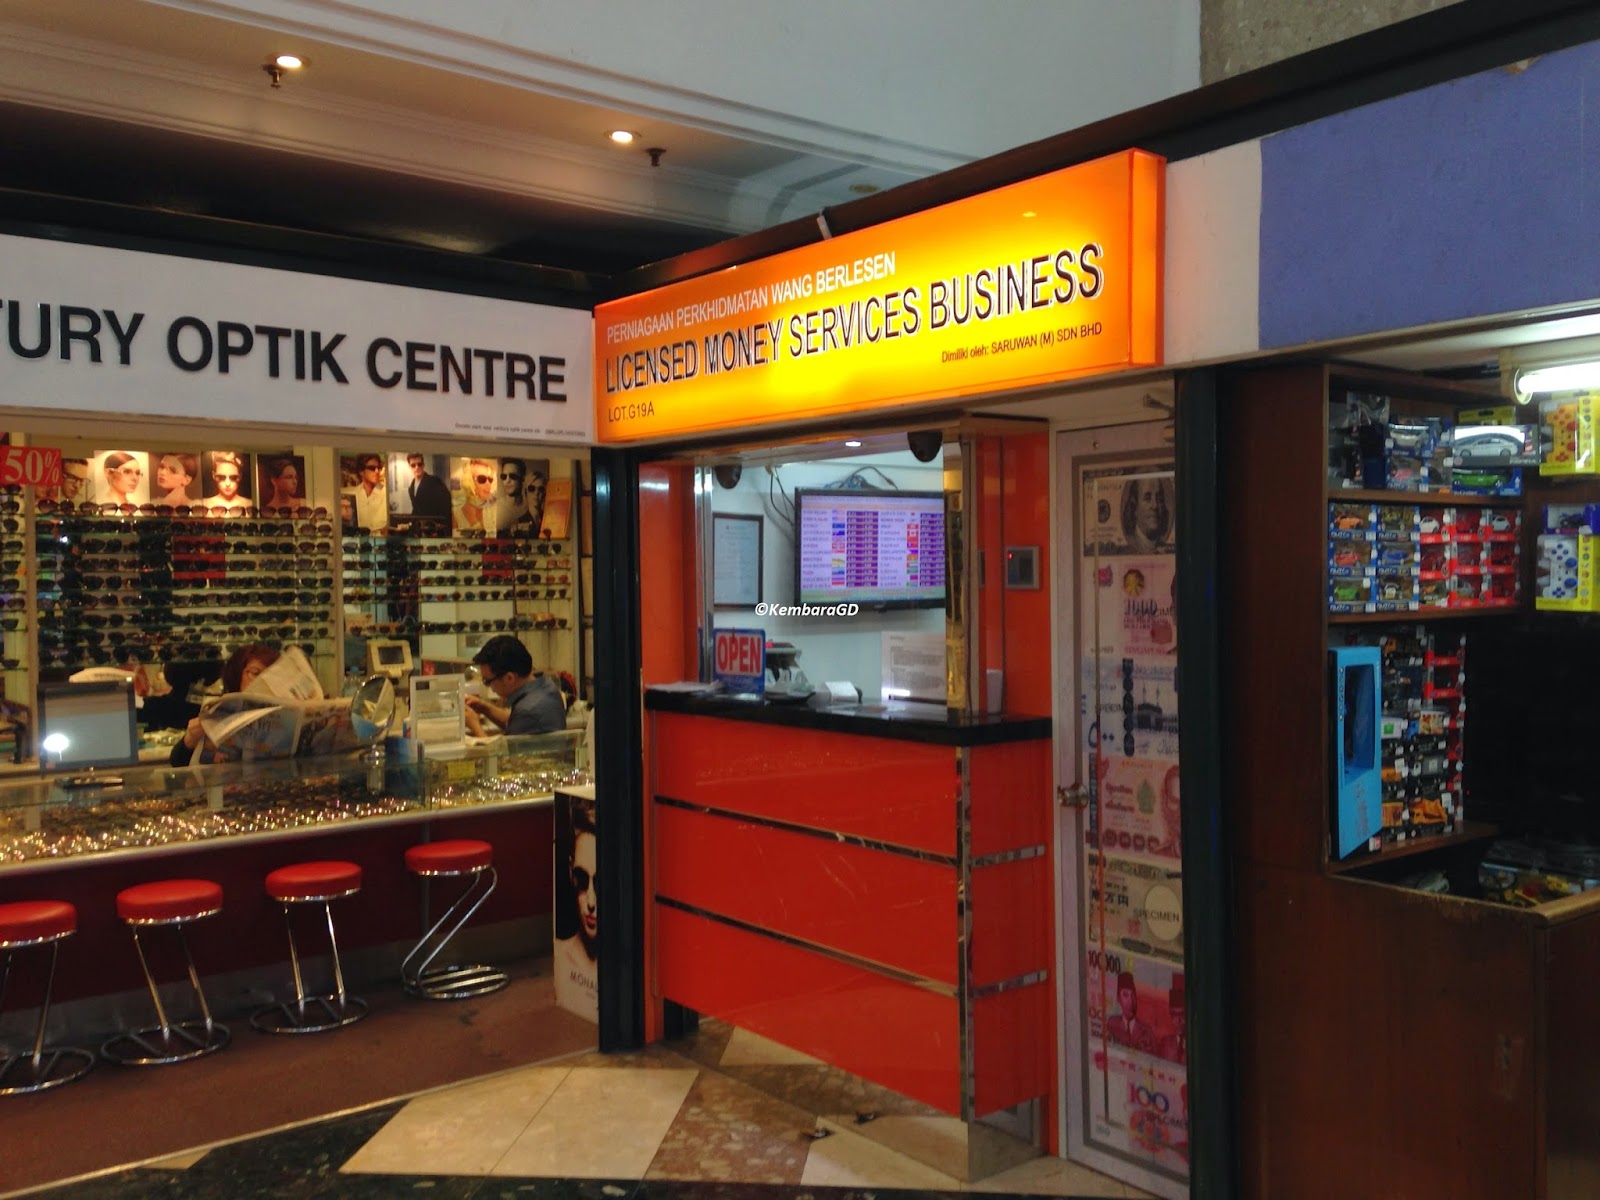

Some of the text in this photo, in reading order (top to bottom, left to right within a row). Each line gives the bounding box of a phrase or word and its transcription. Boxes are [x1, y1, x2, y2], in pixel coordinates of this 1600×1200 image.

[607, 251, 896, 344] PERNIAGAAN PERKHIDMATAN WANG BERLESEN
[606, 242, 1104, 393] LICENSED MONEY SERVICES BUSINESS
[0, 298, 567, 403] URY OPTIK CENTRE
[970, 344, 990, 358] oleh:
[991, 333, 1038, 354] SARUWAN
[1039, 329, 1055, 349] (M)
[1057, 326, 1078, 343] SDN
[1080, 321, 1103, 338] BHD
[608, 401, 655, 423] LOT.G19A
[4, 449, 60, 483] 50%
[717, 634, 761, 674] OPEN
[1134, 908, 1180, 922] SPECIMEN
[570, 970, 598, 991] MONA
